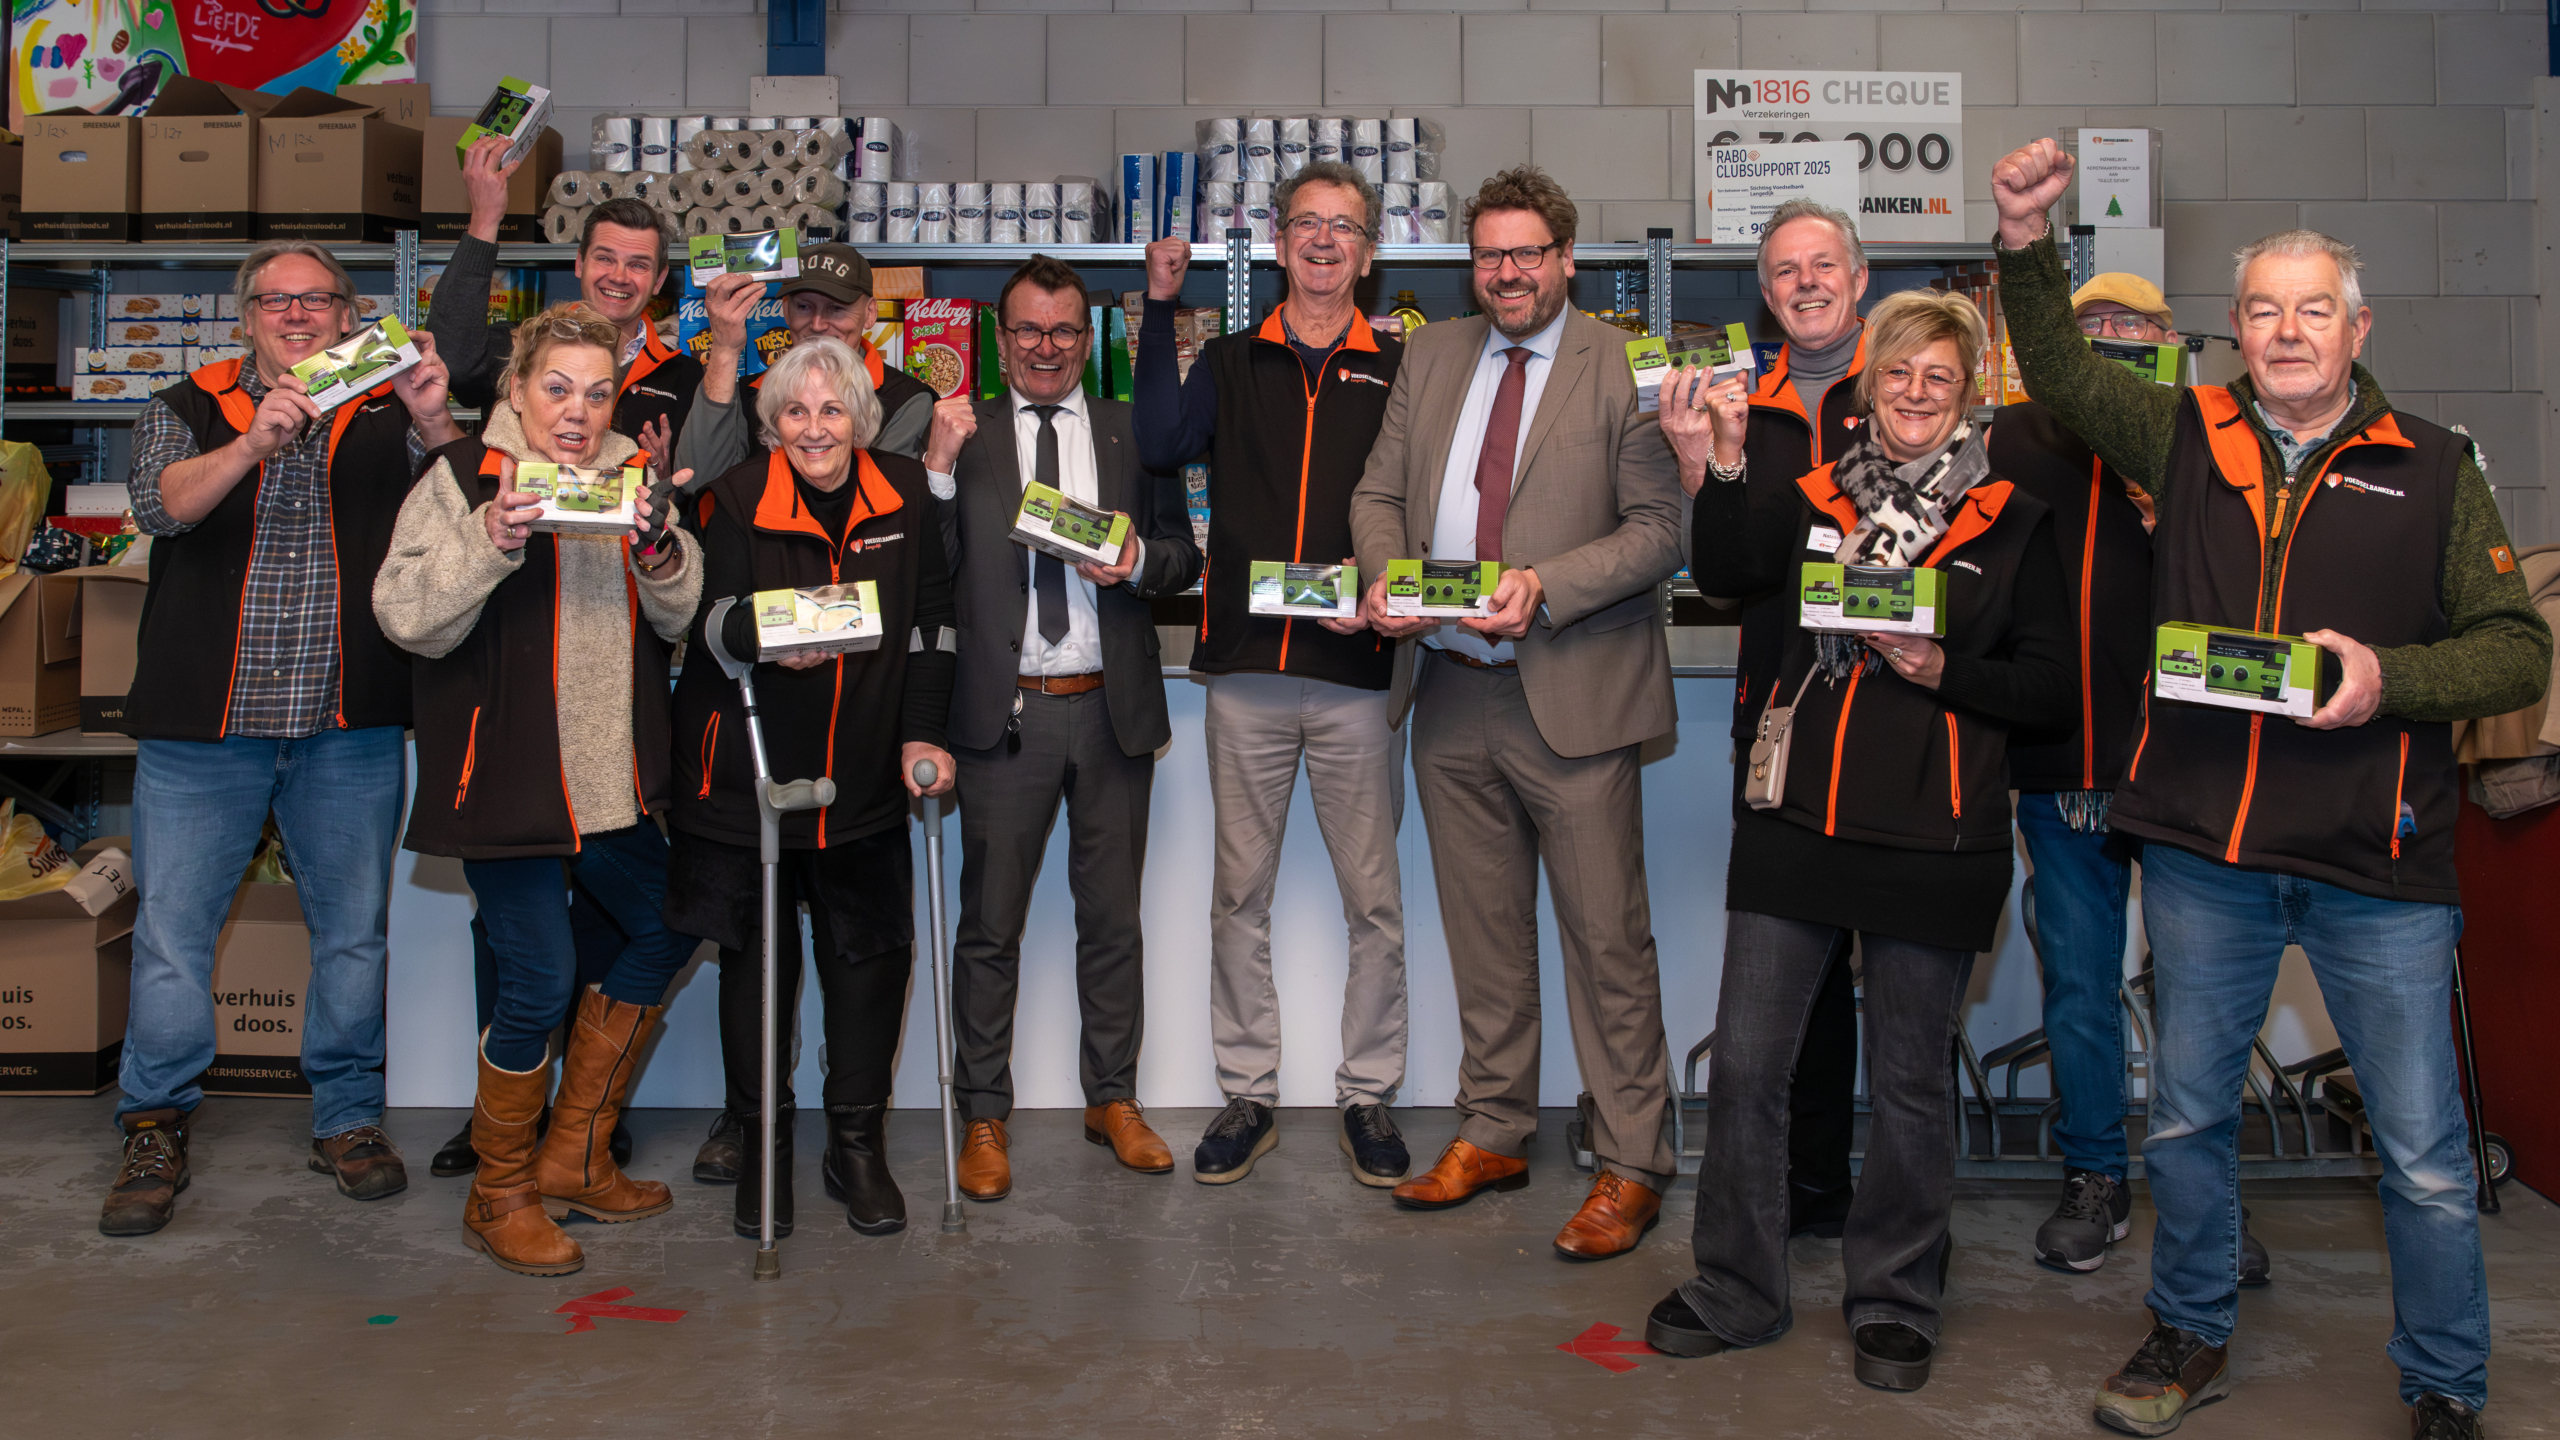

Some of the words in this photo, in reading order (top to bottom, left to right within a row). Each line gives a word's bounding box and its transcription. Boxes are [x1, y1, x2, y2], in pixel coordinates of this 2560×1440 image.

[1823, 81, 1950, 106] CHEQUE
[1742, 110, 1810, 120] Verzekeringen
[203, 121, 242, 129] BREEKBAAR
[1716, 149, 1747, 163] RABO
[1716, 162, 1801, 178] CLUBSUPPORT
[1804, 161, 1831, 175] 2025
[1859, 197, 1952, 214] ANKEN.NL
[33, 222, 110, 230] verhuisdozenloods.nl
[155, 221, 233, 230] verhuisdozenloods.nl
[270, 222, 346, 230] verhuisdozenloods.nl
[1751, 223, 1767, 234] 90
[2344, 476, 2405, 497] VOEDSELBANKEN.NL
[1952, 560, 1982, 575] BANKEN.NL
[212, 989, 296, 1007] verhuis
[234, 1014, 293, 1033] doos.
[207, 1067, 298, 1079] VERHUISSERVICE+
